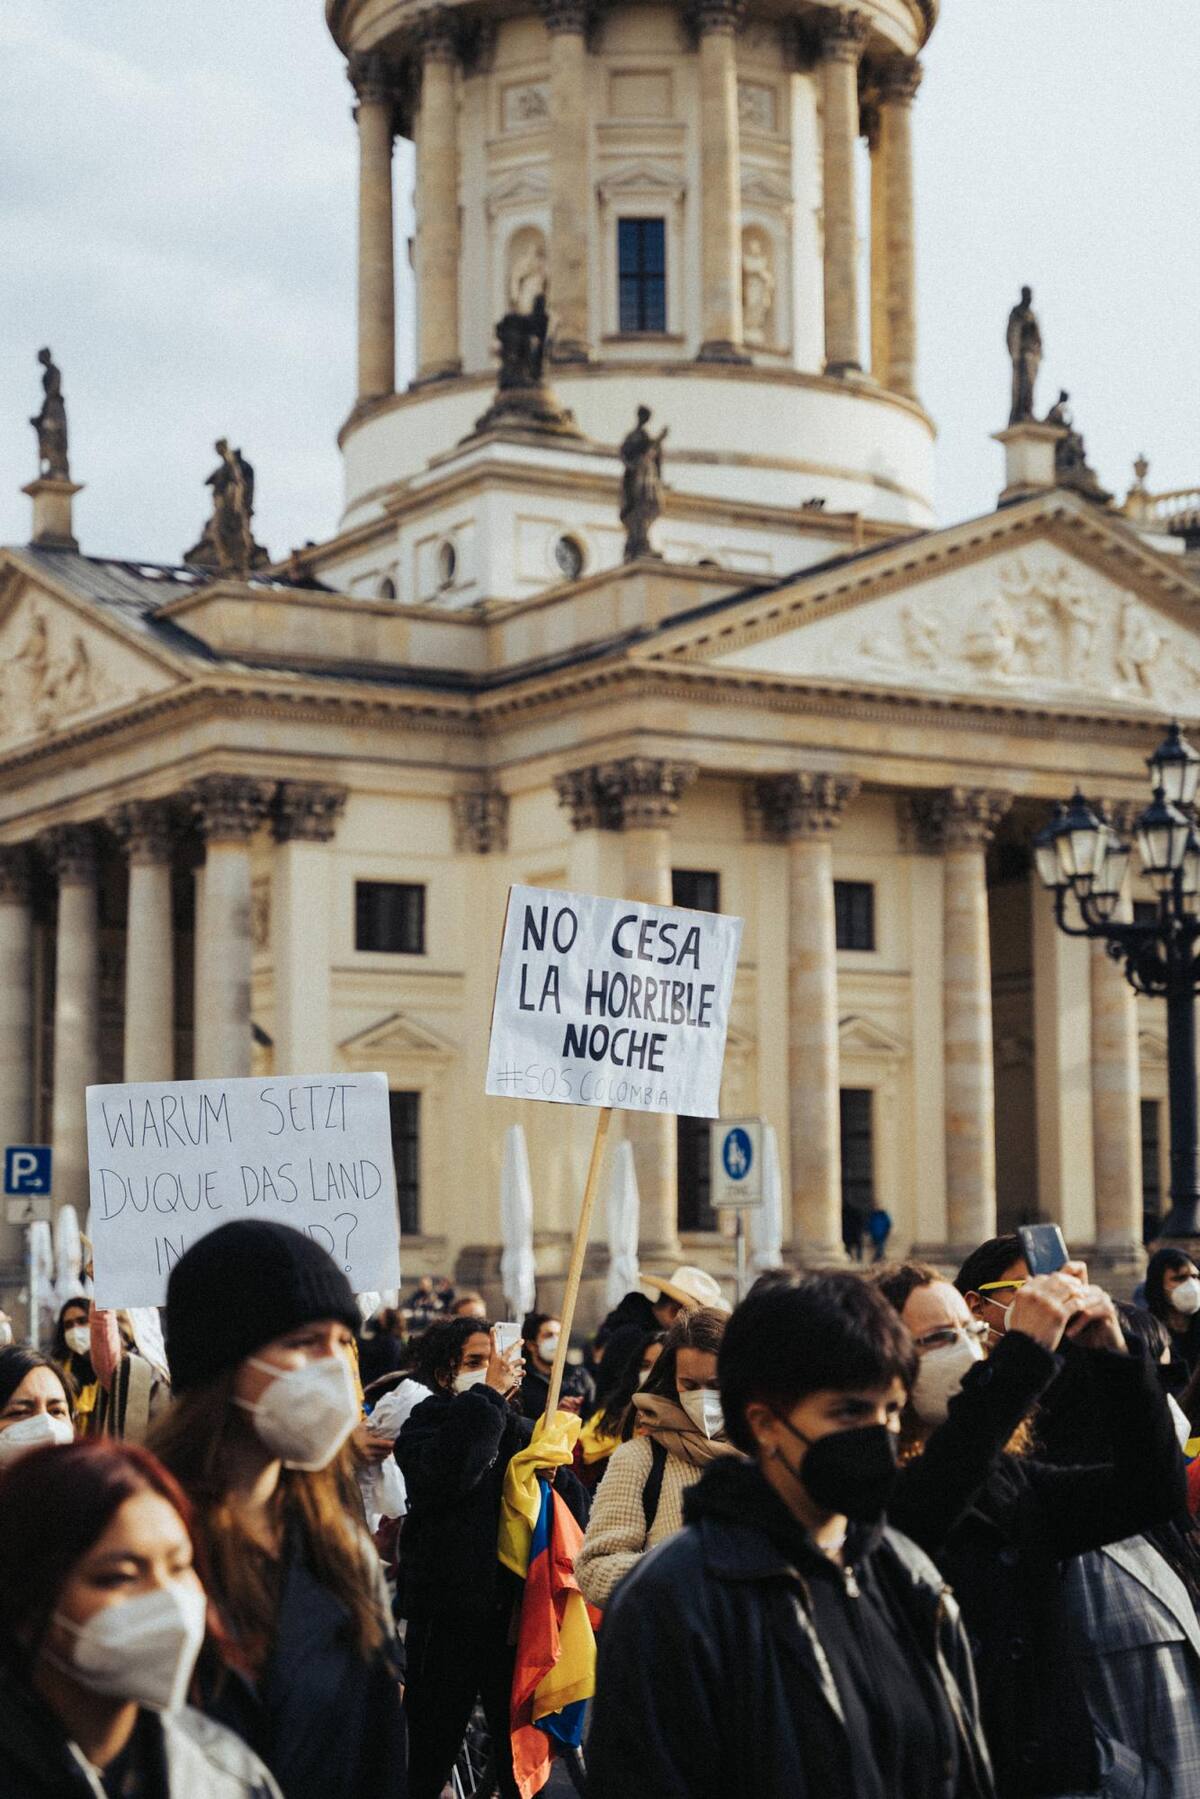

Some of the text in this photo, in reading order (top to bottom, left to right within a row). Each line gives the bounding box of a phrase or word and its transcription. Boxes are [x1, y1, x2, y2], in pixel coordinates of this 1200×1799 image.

[522, 905, 701, 970] NO CESA
[519, 963, 715, 1028] LA HORRIBLE
[562, 1023, 668, 1073] NOCHE
[102, 1085, 357, 1148] WARUM SETZT
[11, 1152, 38, 1190] P
[99, 1158, 382, 1221] DUQUE DAS LAND
